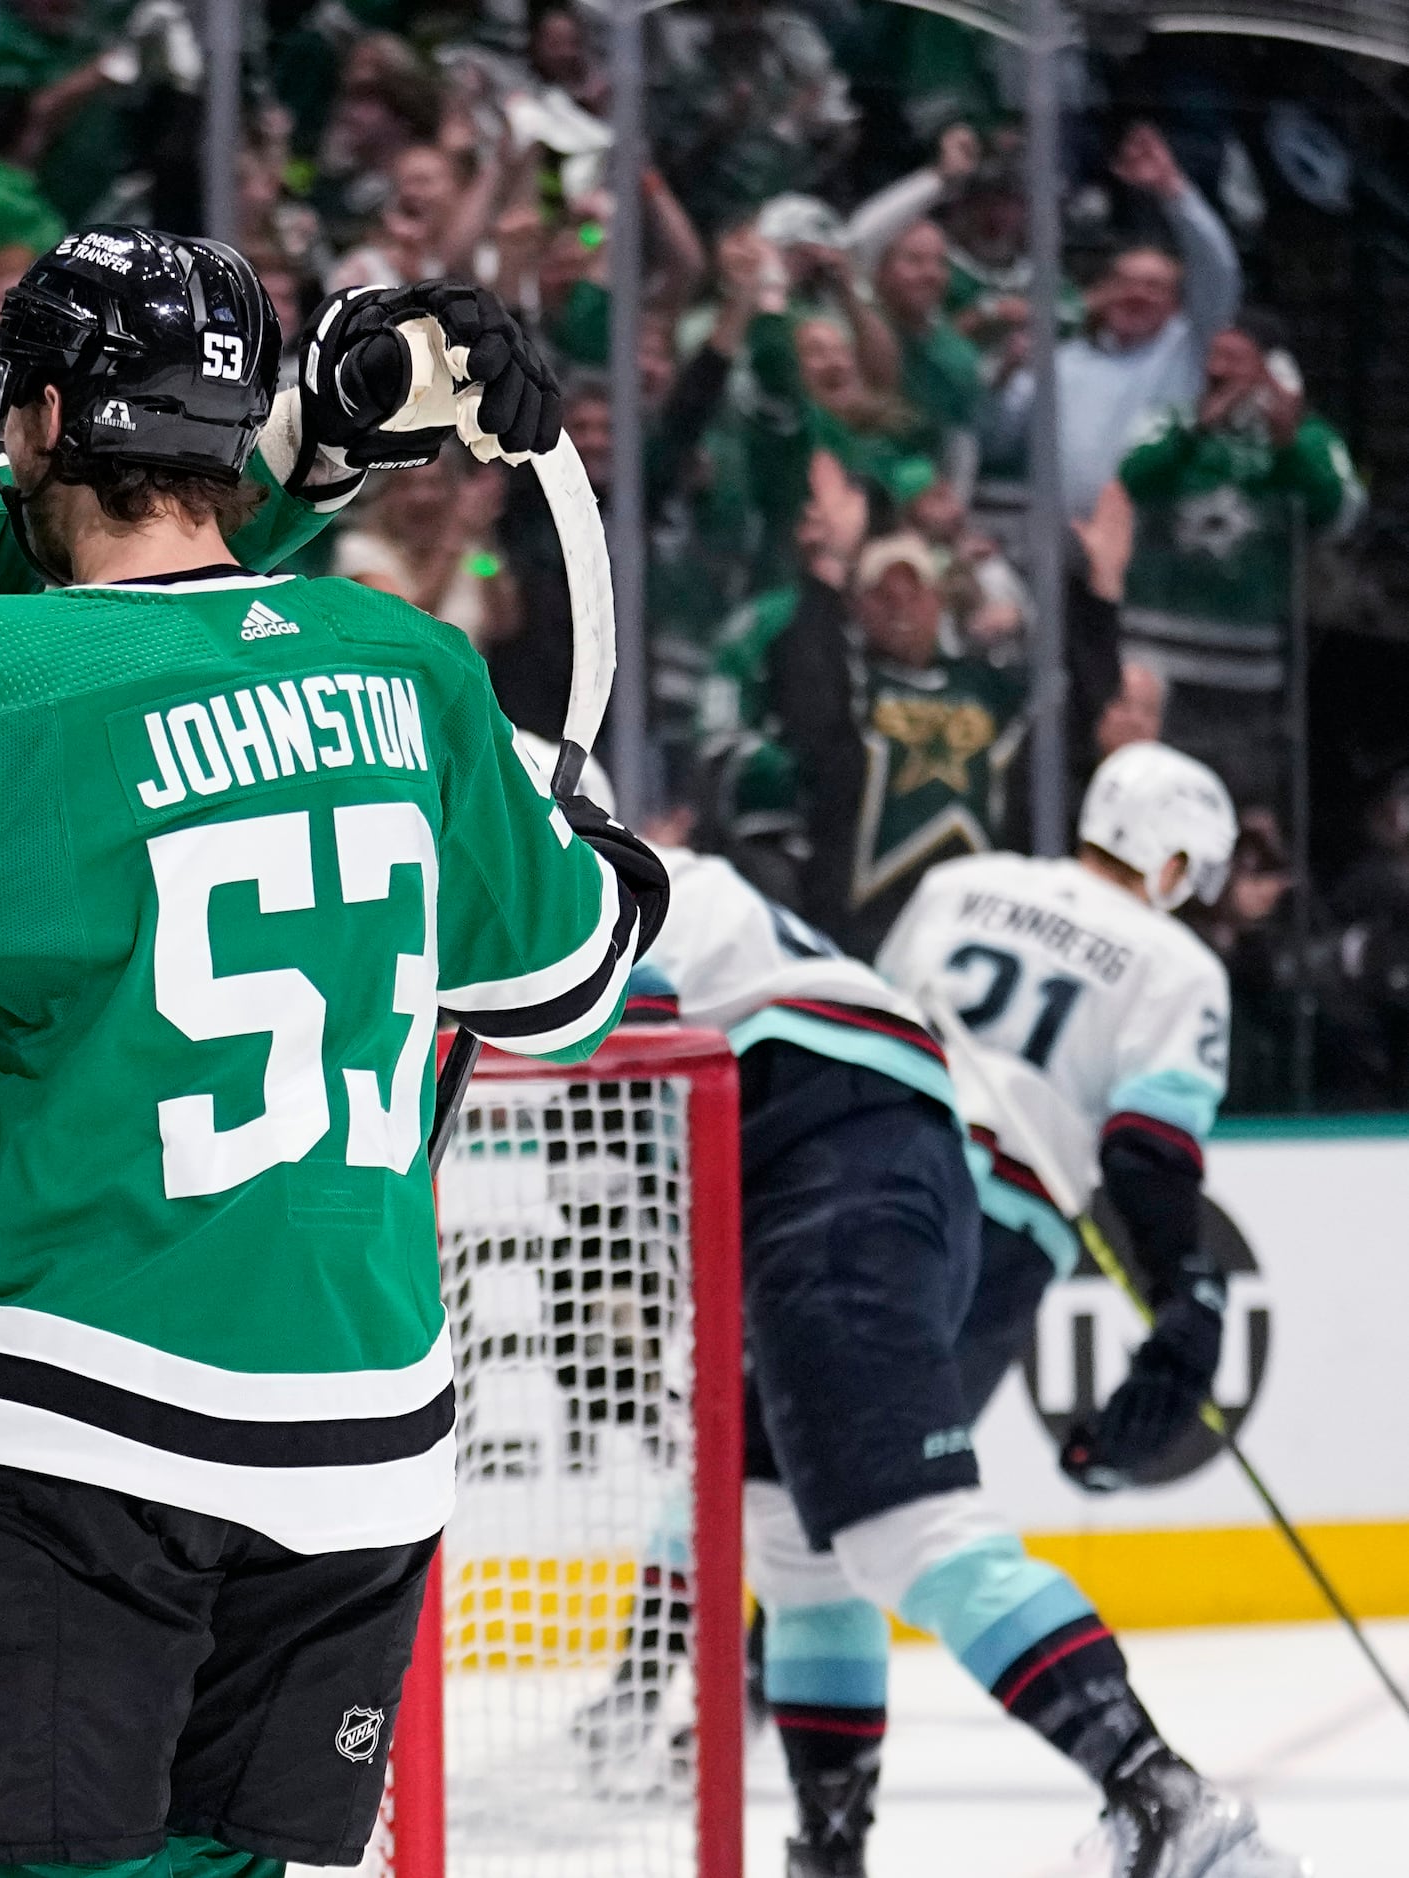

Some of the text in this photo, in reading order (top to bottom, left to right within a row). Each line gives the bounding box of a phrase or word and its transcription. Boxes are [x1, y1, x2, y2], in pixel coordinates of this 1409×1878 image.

[72, 244, 133, 275] TRANSFER
[202, 331, 244, 381] 53
[94, 415, 137, 431] ALLENSTRONG
[240, 621, 301, 641] adidas
[136, 673, 429, 810] JOHNSTON
[958, 892, 1137, 987] WENNBERG
[146, 801, 439, 1200] 53
[945, 941, 1083, 1070] 21
